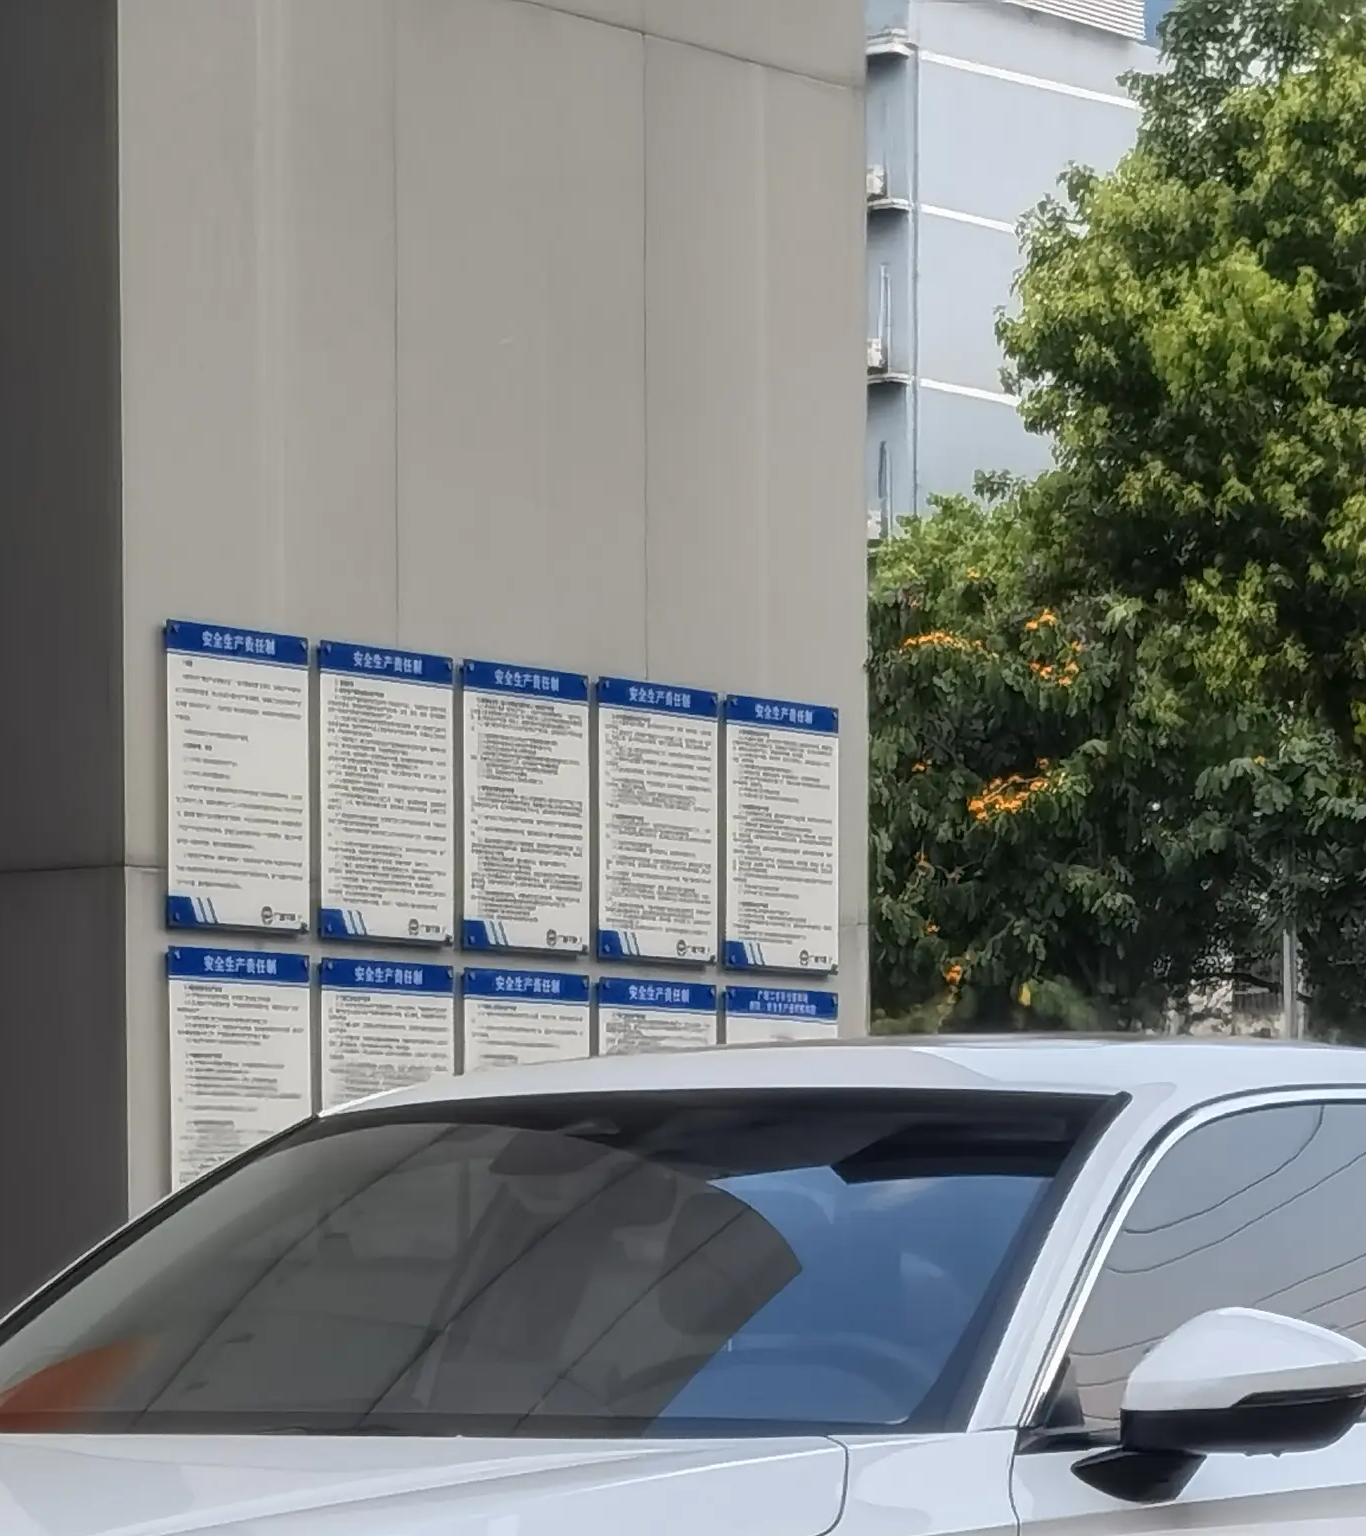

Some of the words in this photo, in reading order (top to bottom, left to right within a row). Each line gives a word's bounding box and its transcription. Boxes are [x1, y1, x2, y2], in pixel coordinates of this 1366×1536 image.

[202, 631, 275, 655] 安全生产责任制
[353, 651, 423, 674] 安全生产责任制
[494, 669, 560, 692] 安全生产责任制
[629, 687, 691, 708] 安全生产责任制
[755, 703, 813, 725] 安全生产责任制
[203, 955, 277, 975] 安全生产责任制
[355, 966, 423, 985] 安全生产责任制
[495, 975, 560, 994] 安全生产责任制
[629, 985, 690, 1003] 安全生产责任制
